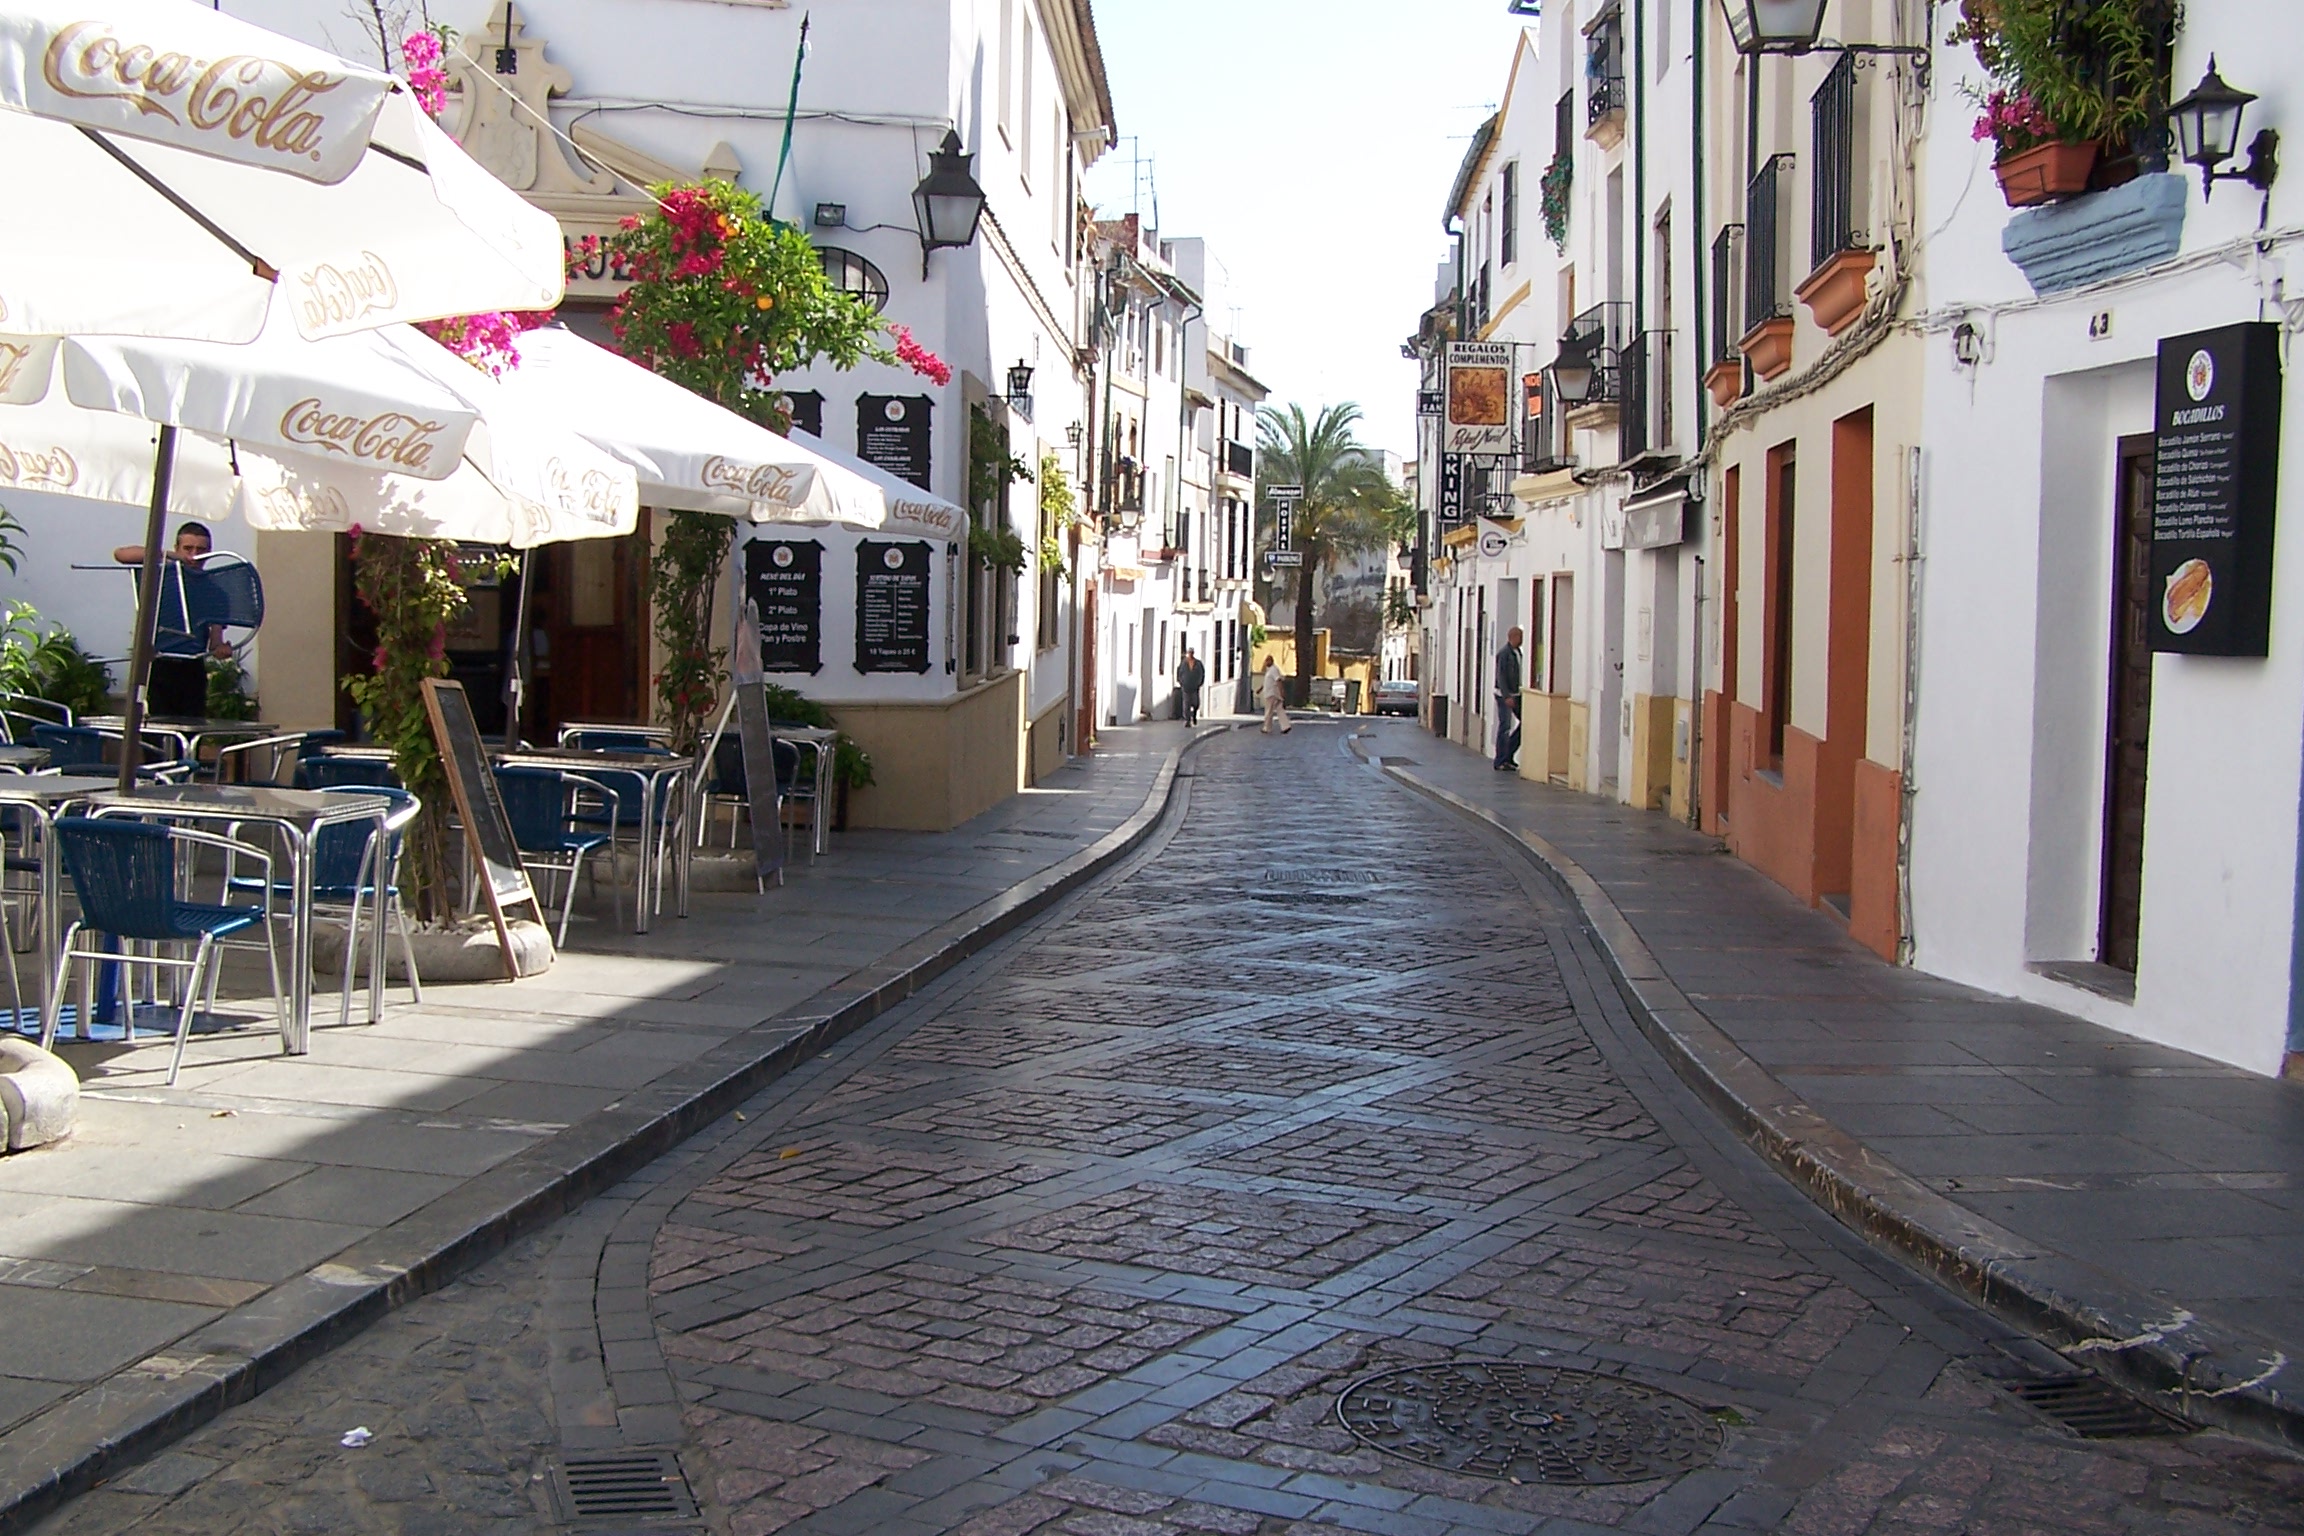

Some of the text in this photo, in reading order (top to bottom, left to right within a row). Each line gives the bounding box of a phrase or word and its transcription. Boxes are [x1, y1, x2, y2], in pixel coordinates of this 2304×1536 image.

[43, 20, 347, 160] Coca-Cola
[1454, 343, 1506, 353] REGALOS
[1449, 353, 1510, 365] COMPLEMENTOS
[2172, 404, 2225, 426] BOCADILLOS
[280, 398, 448, 472] Coca-Cola
[701, 455, 799, 504] Coca-Cola
[893, 498, 955, 529] Coca-Cola
[1280, 502, 1288, 550] HOSTAL
[777, 586, 798, 597] Plato
[777, 605, 798, 615] Plato
[759, 622, 809, 634] Copa de Vino
[781, 633, 807, 643] Postre
